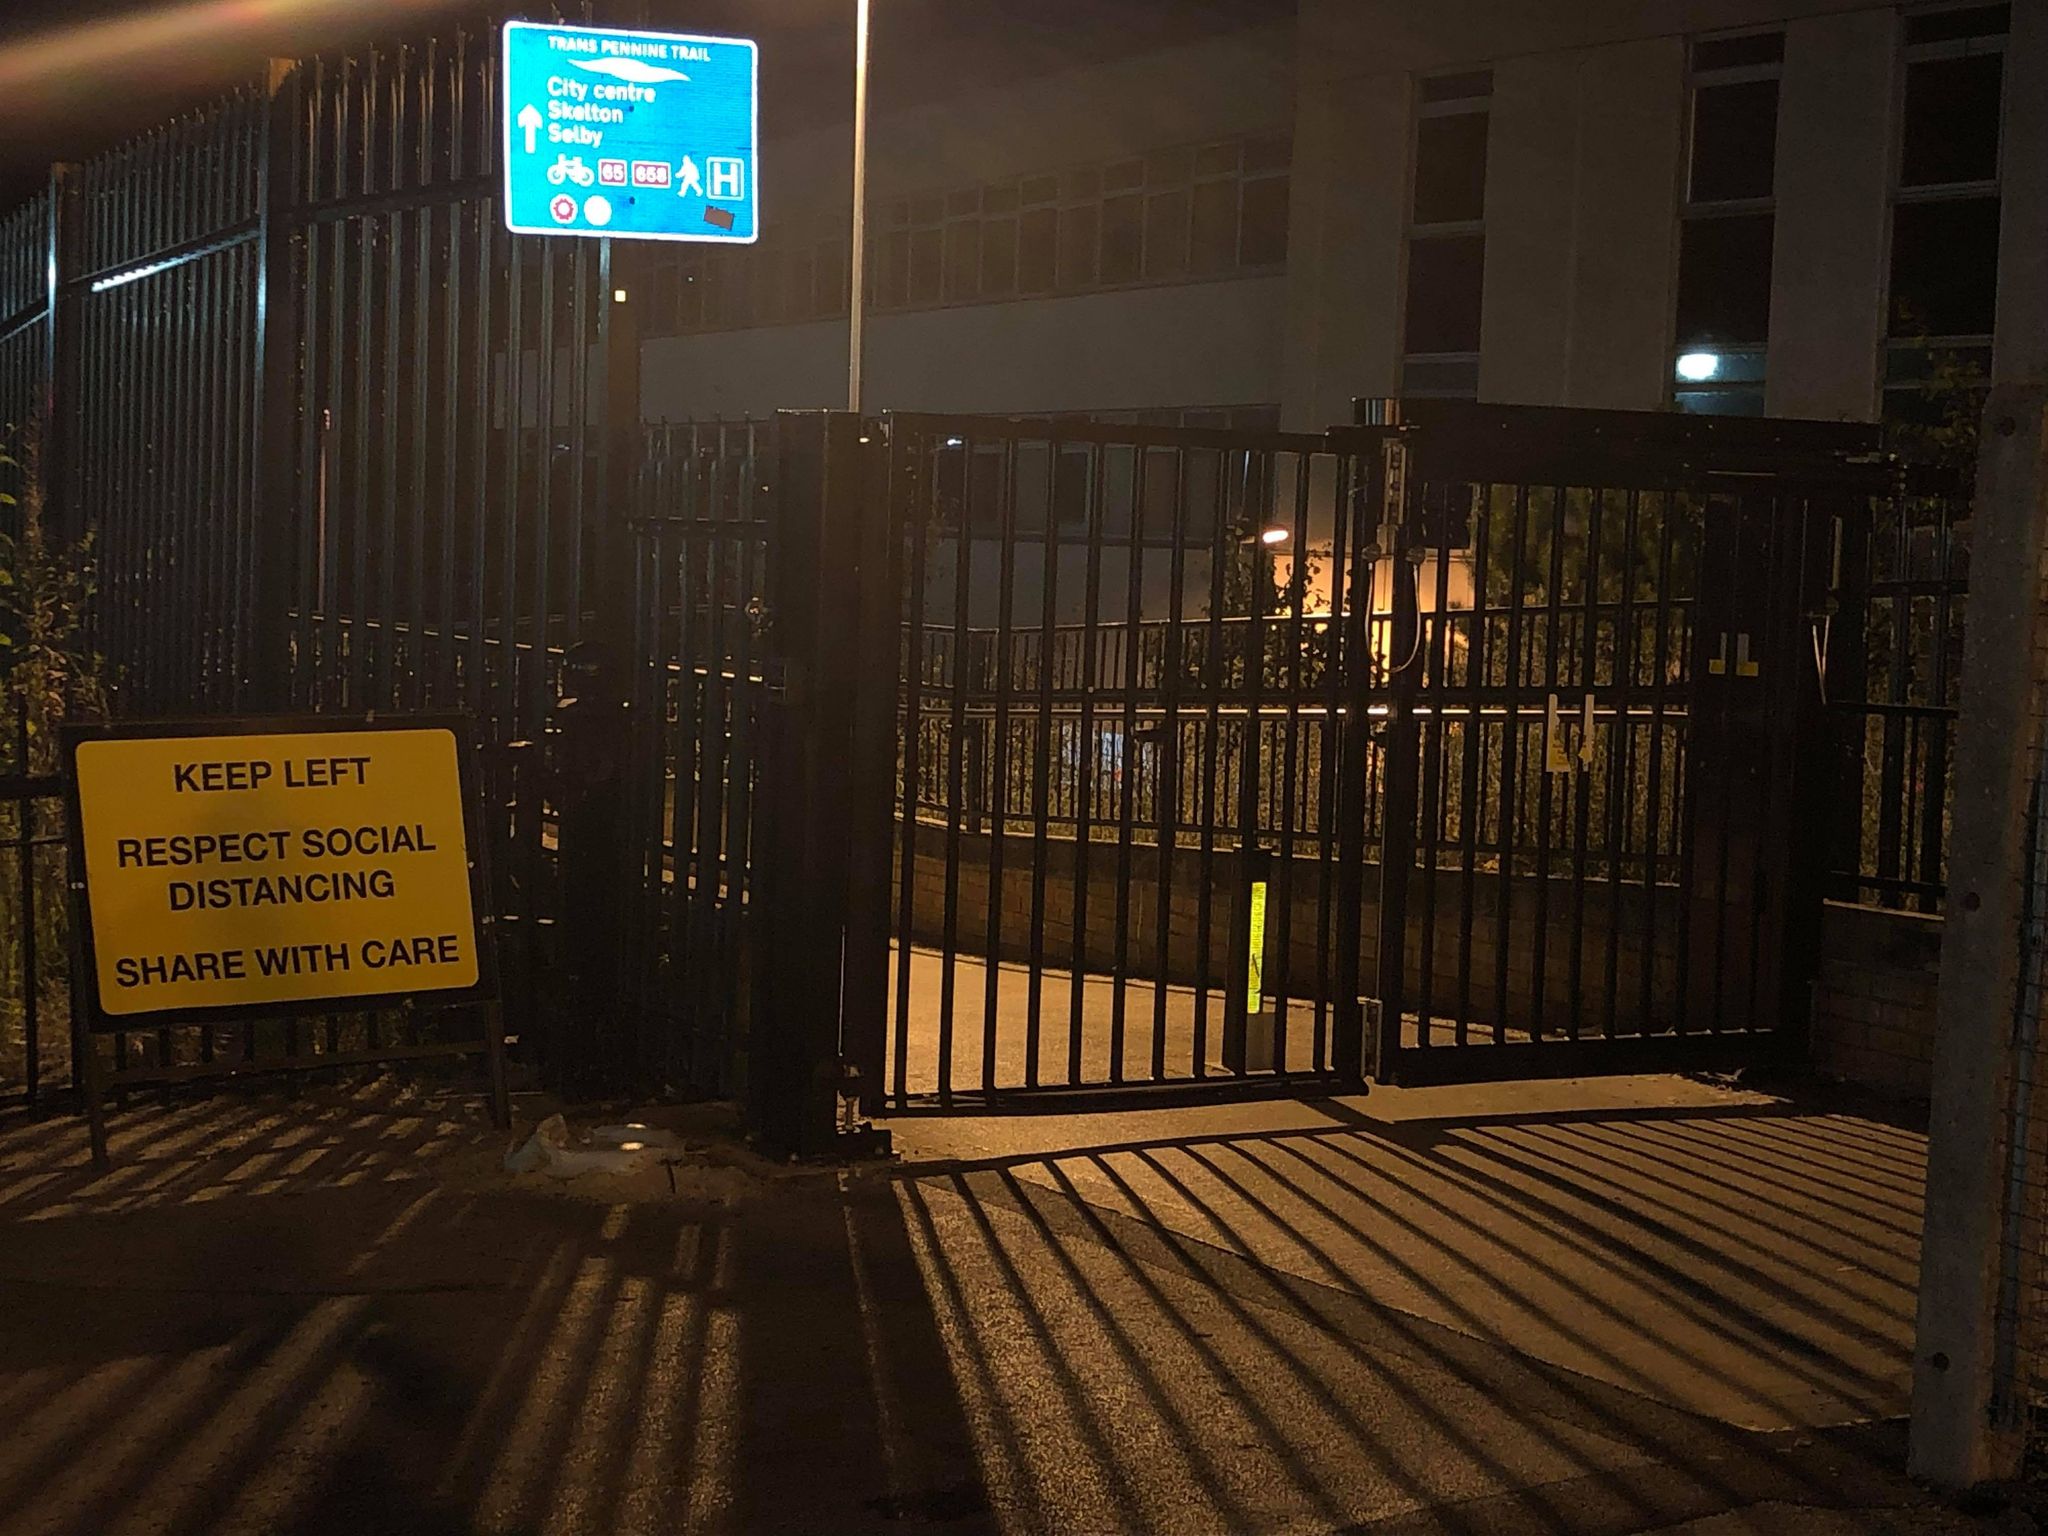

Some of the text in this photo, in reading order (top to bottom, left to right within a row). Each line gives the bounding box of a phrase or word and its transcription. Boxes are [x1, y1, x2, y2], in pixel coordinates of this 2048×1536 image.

[548, 35, 711, 62] TRANS PENNINE TRAIL
[546, 77, 656, 102] City centre
[547, 101, 623, 123] Skelton
[547, 124, 603, 149] Selby
[602, 164, 625, 182] 65
[713, 162, 737, 196] H
[173, 756, 371, 792] KEEP LEFT
[117, 824, 437, 868] RESPECT SOCIAL
[169, 869, 395, 910] DISTANCING
[115, 935, 459, 987] SHARE WITH CARE
